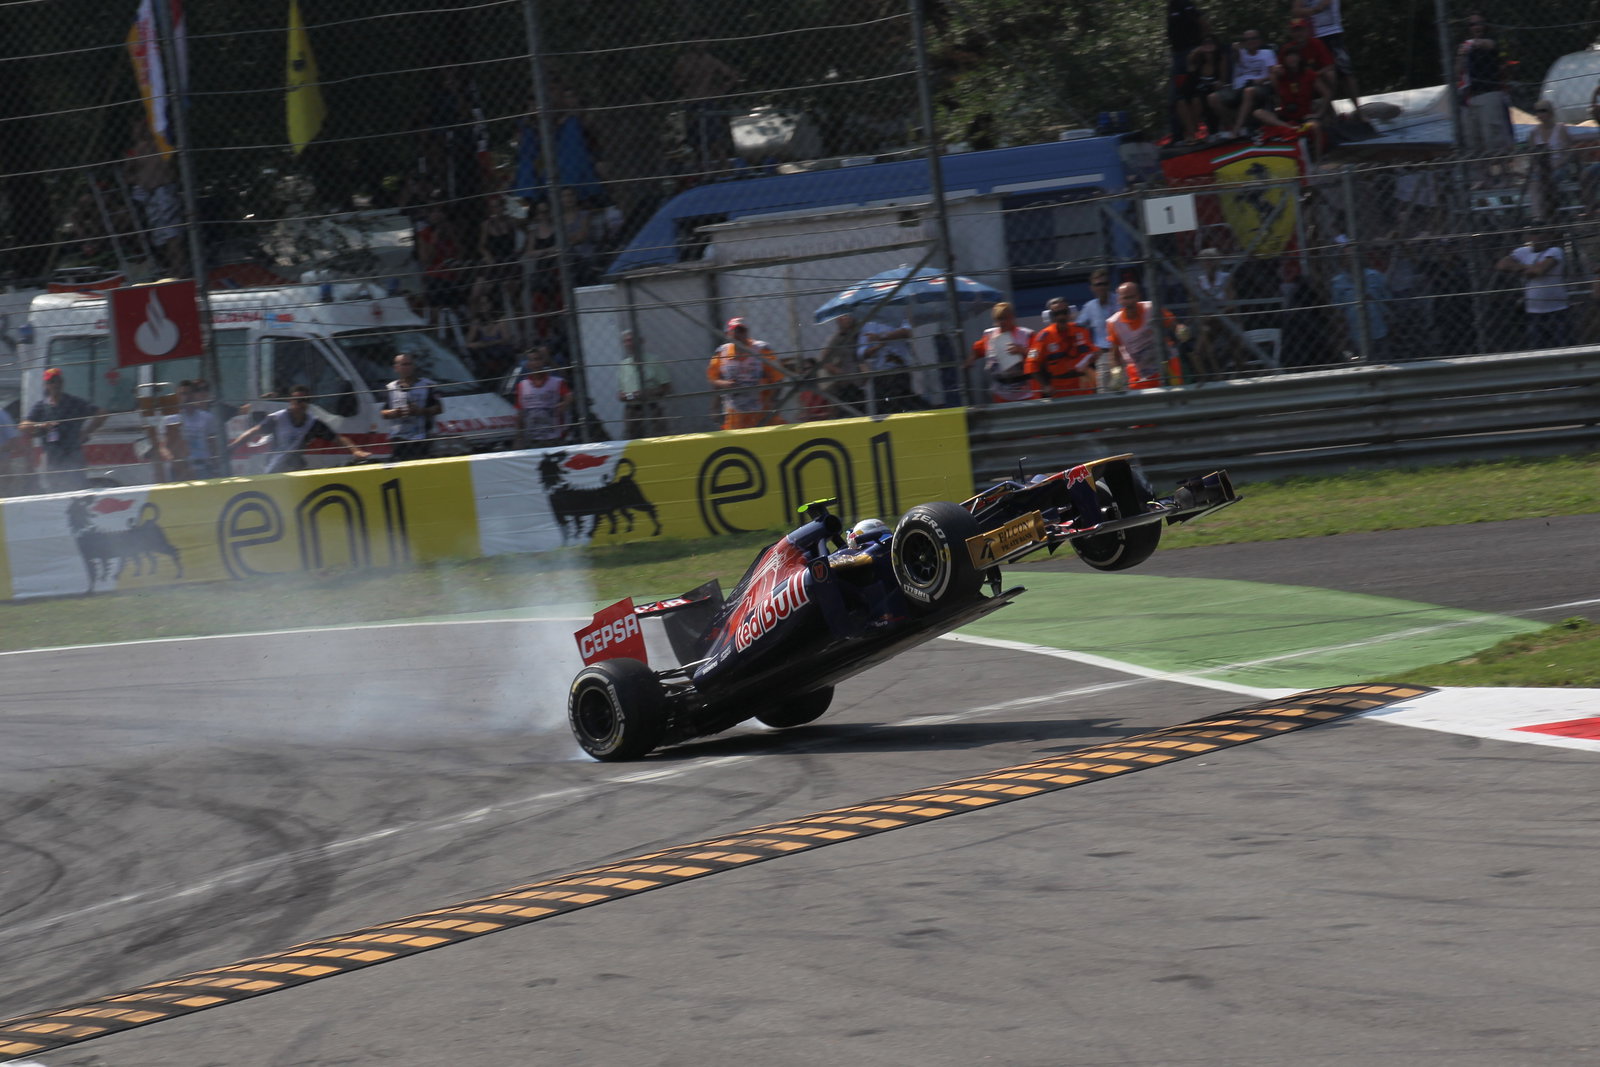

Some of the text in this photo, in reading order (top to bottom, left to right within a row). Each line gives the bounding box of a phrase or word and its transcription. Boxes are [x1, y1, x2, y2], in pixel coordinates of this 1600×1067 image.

[1164, 205, 1175, 225] 1
[697, 431, 898, 536] eni
[217, 478, 414, 581] eni
[911, 513, 947, 539] ZERO
[580, 613, 639, 659] CEPSA
